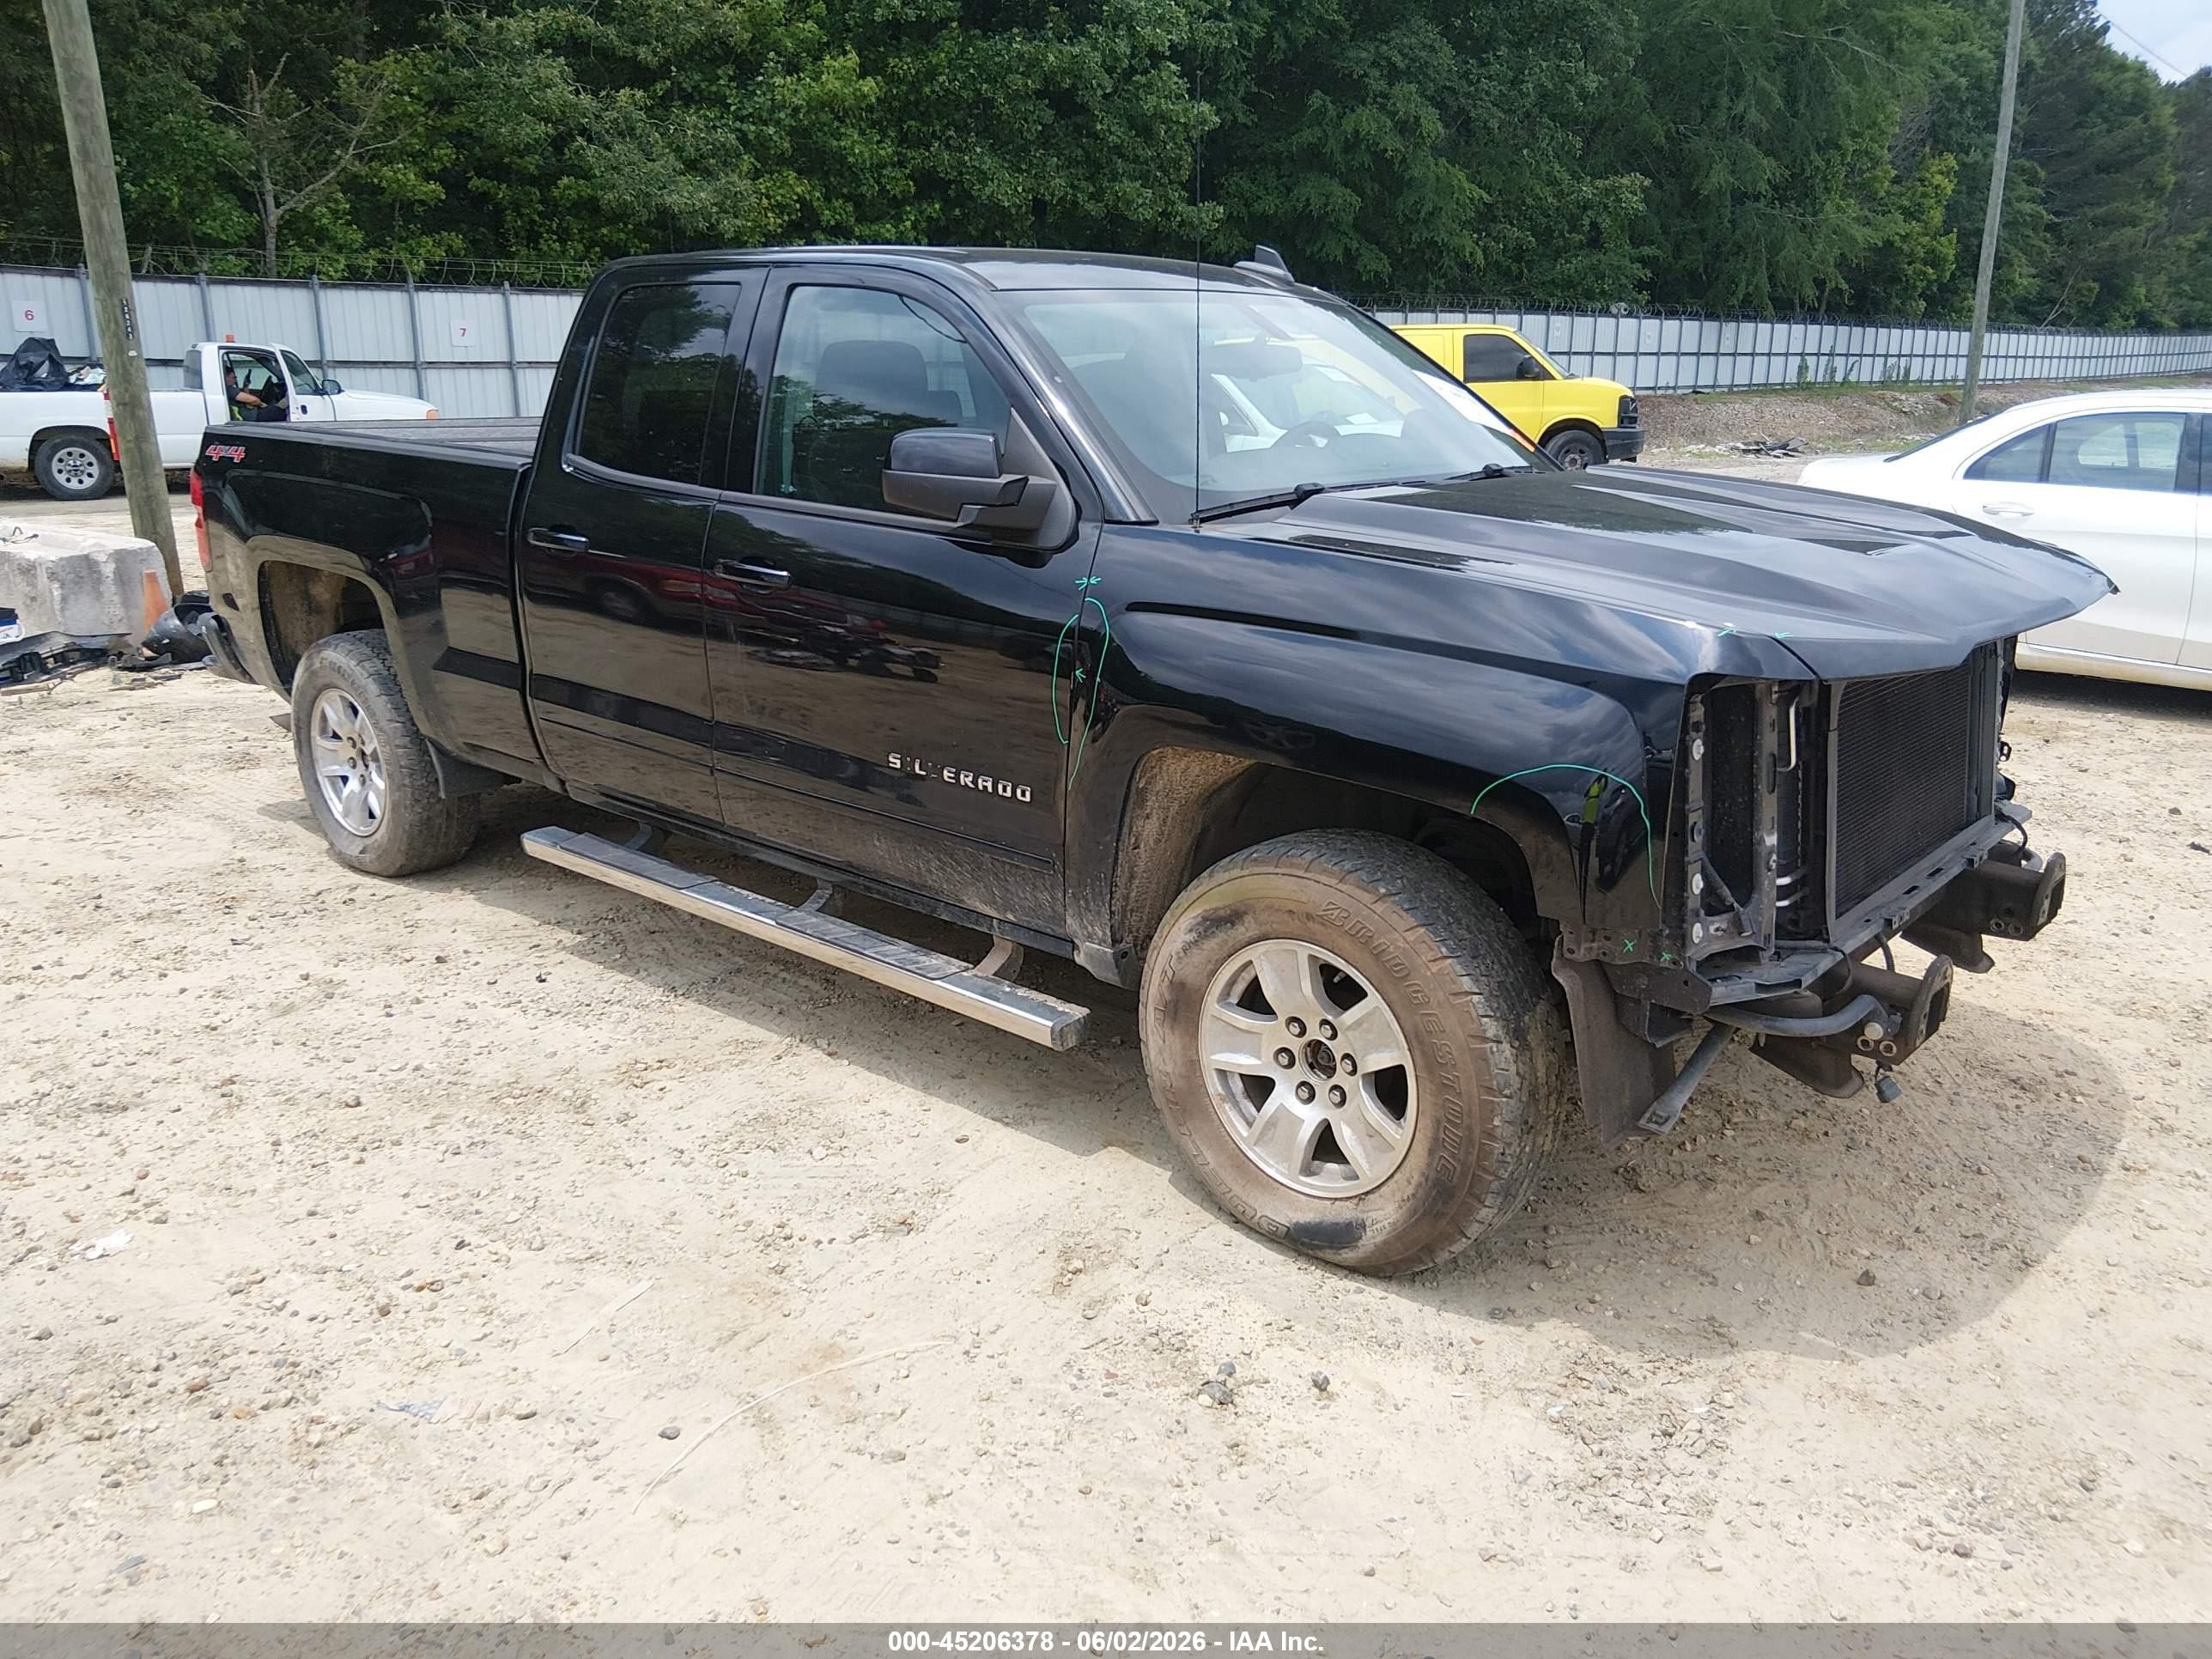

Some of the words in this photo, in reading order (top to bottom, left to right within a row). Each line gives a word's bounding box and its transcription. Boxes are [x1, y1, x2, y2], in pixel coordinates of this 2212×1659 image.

[24, 309, 34, 320] 6
[459, 327, 467, 337] 7
[888, 752, 1031, 803] SLERADO
